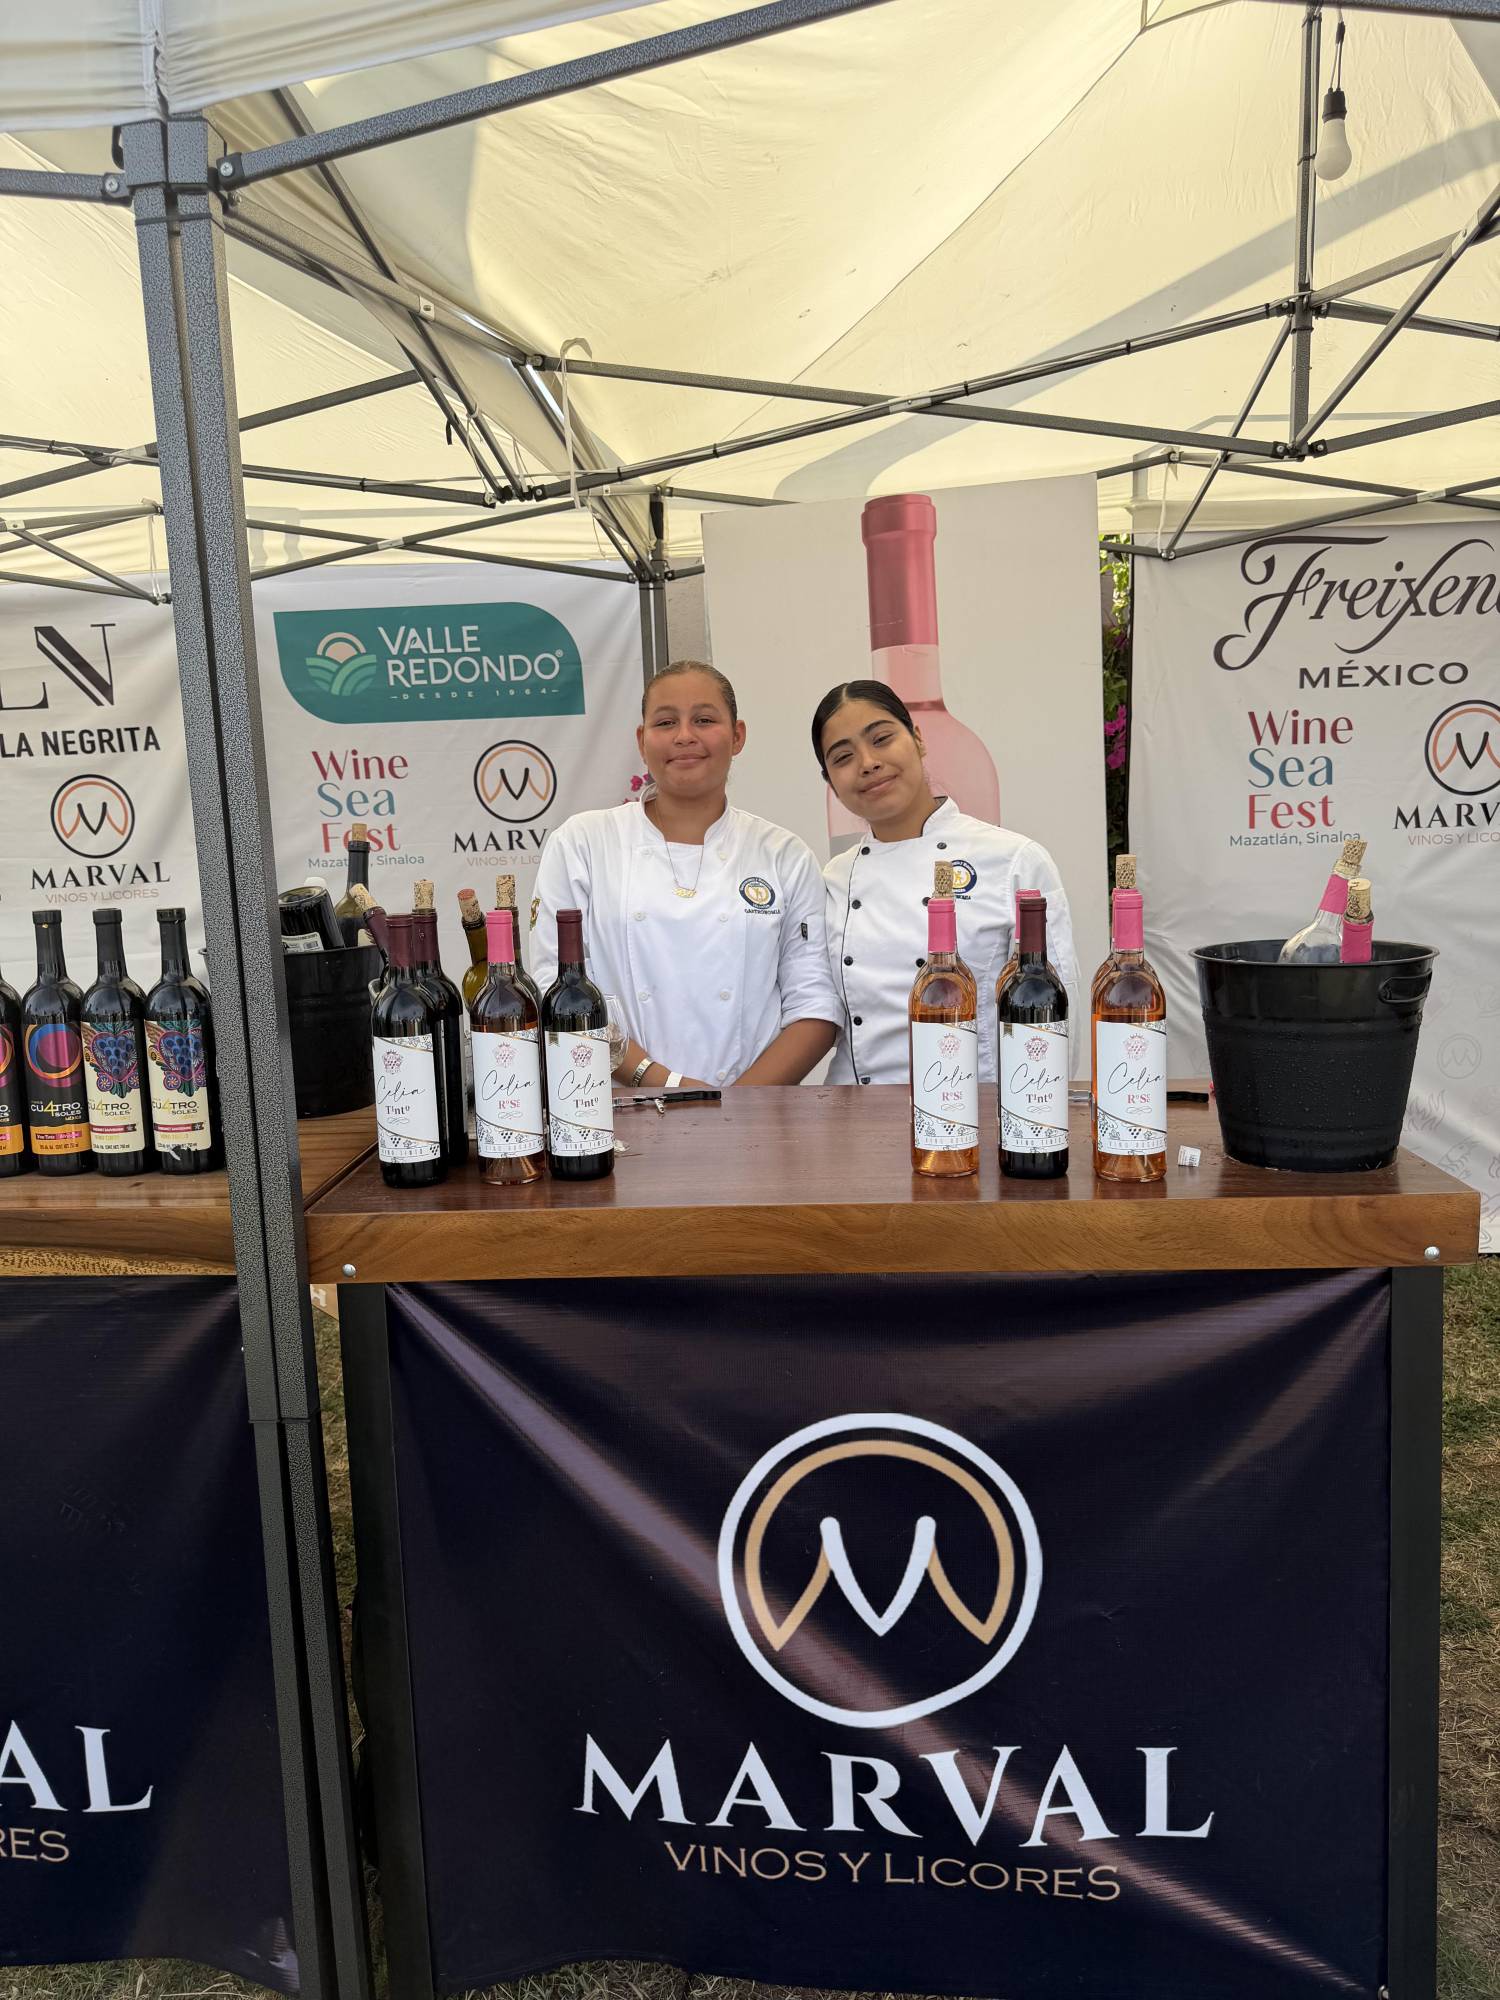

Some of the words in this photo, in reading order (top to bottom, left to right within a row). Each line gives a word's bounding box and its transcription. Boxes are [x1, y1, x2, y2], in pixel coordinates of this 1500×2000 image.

[1213, 535, 1500, 671] Freixen
[378, 625, 481, 655] VALLE
[1299, 659, 1469, 689] MÉXICO
[402, 691, 474, 700] DESDE
[0, 732, 34, 758] LA
[41, 726, 161, 756] NEGRITA
[1247, 709, 1354, 746] Wine
[311, 749, 409, 782] Wine
[1247, 747, 1334, 788] Sea
[317, 782, 397, 818] Sea
[1248, 794, 1336, 829] Fest
[1229, 832, 1303, 848] Mazatlán,
[1408, 833, 1454, 846] VINOS
[1456, 832, 1465, 844] Y
[30, 861, 171, 890] MARVAL
[307, 855, 374, 869] Mazat,
[376, 854, 425, 866] Sinaloa
[466, 856, 508, 867] VINOS
[510, 855, 518, 866] Y
[45, 891, 90, 905] VINOS
[91, 891, 99, 903] Y
[101, 888, 160, 902] LICORES
[573, 1732, 1214, 1848] MARVAL
[664, 1840, 829, 1883] VINOS
[838, 1852, 873, 1883] Y
[883, 1855, 1122, 1901] LICORES
